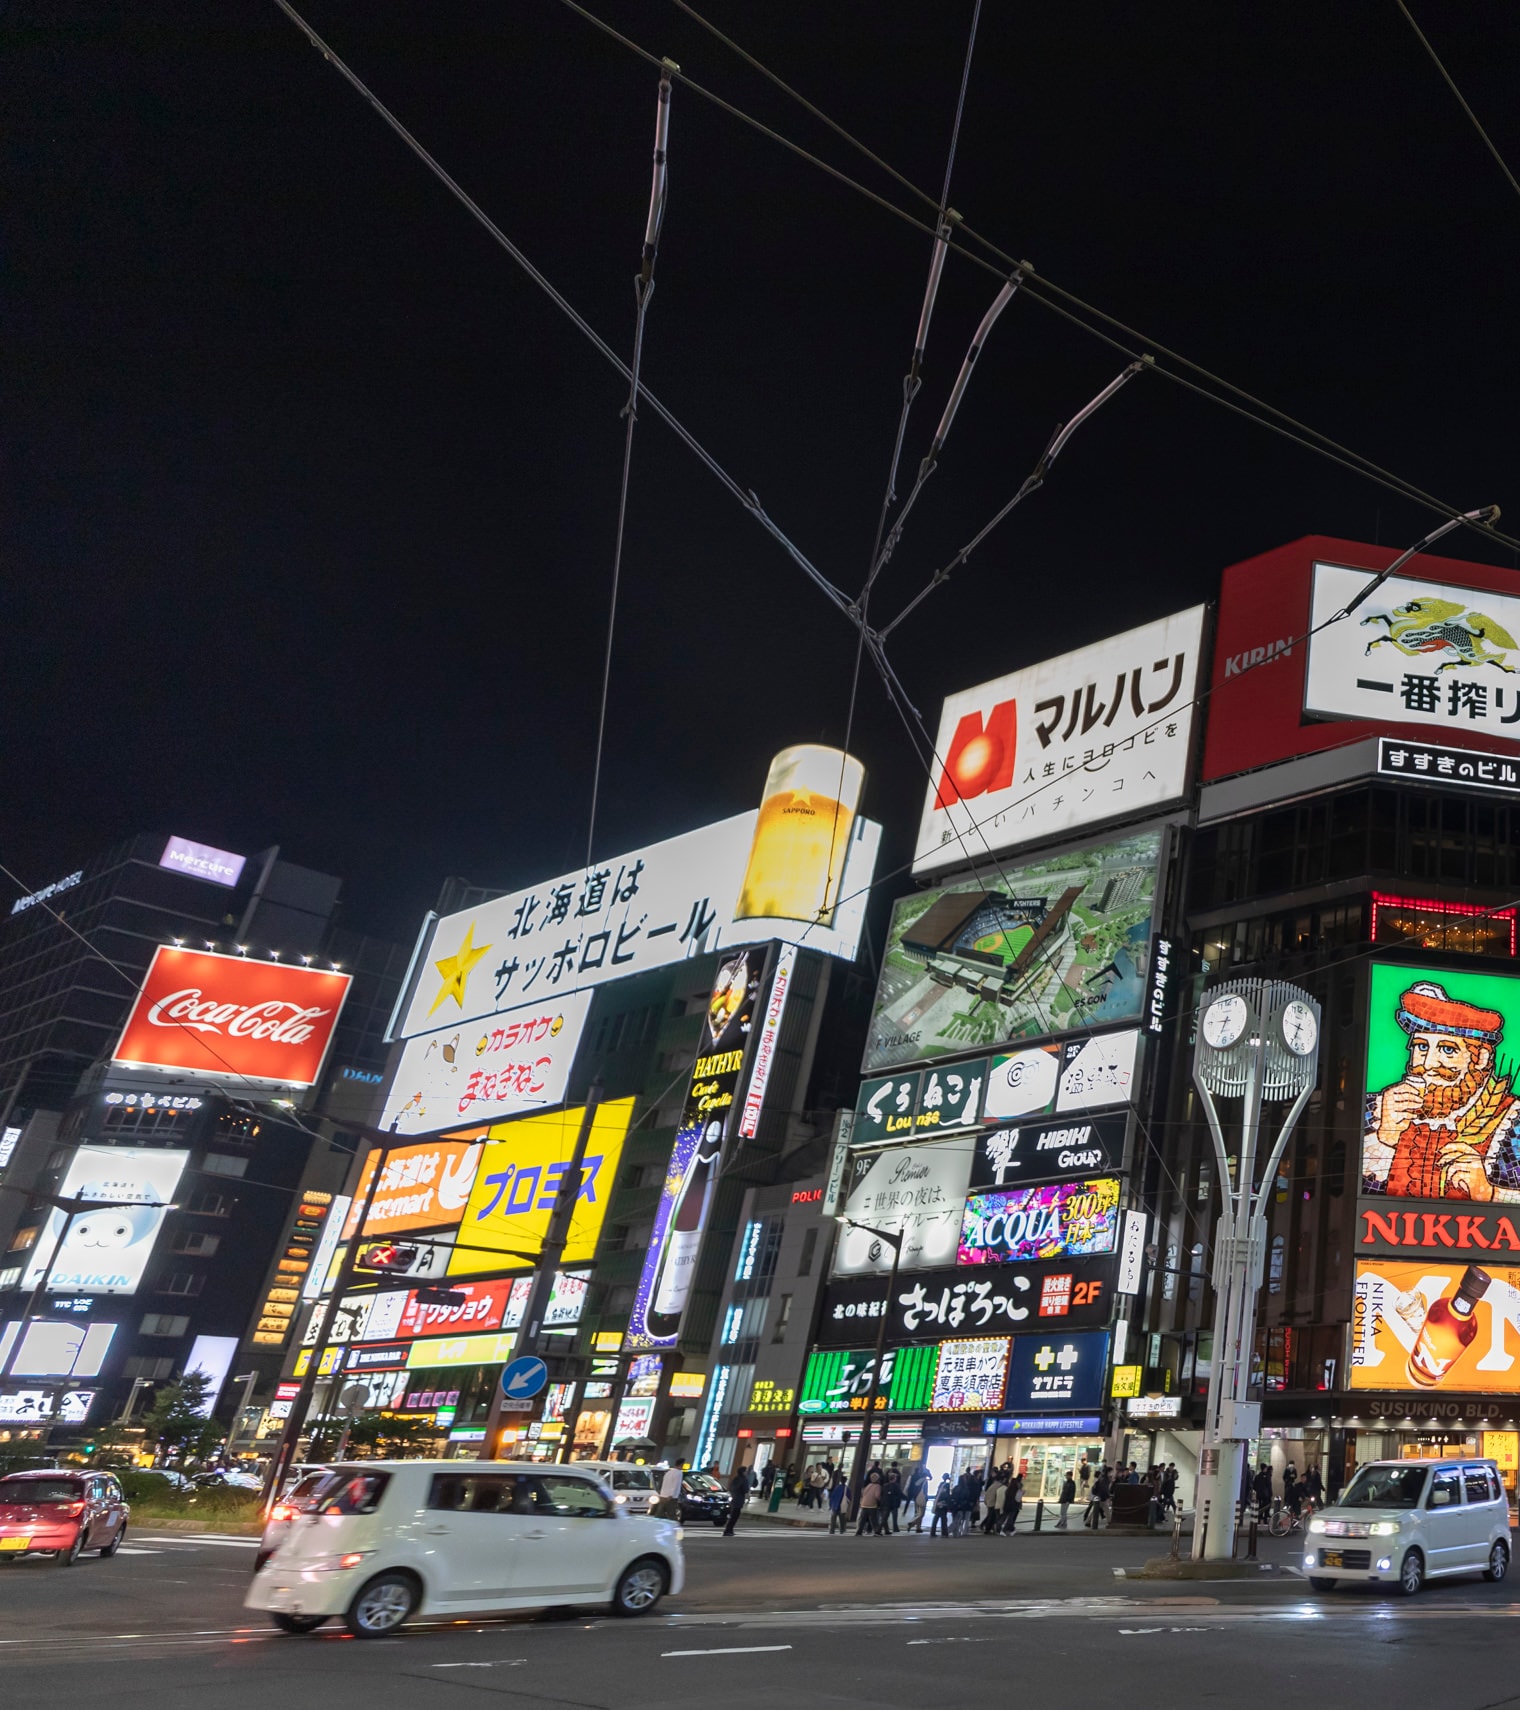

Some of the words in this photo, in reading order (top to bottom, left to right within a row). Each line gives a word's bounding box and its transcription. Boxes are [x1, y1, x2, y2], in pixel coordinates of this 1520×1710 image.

[1224, 636, 1293, 678] KIRIN
[1034, 652, 1185, 750] マルハン
[1388, 749, 1516, 783] すすきのビル
[782, 806, 817, 817] SAPPORO
[169, 850, 234, 876] Mercure
[507, 860, 644, 941] 北海道は
[494, 897, 717, 1003] サッポロビール
[147, 988, 331, 1046] Coca-Cola
[769, 976, 787, 1018] カラオケ
[487, 1015, 554, 1053] カラオケ
[458, 1056, 552, 1113] まねきねこ
[693, 1049, 744, 1079] HATHYR
[1036, 1126, 1092, 1151] HIBIKI
[477, 1155, 603, 1222] プロミス
[966, 1206, 1062, 1249] ACQUA
[1065, 1223, 1110, 1246] 日本一
[52, 1273, 129, 1286] DAIKIN
[1072, 1281, 1103, 1306] 2F
[1352, 1281, 1369, 1366] FRONTIER
[1370, 1282, 1384, 1337] NIKKA
[1369, 1401, 1459, 1418] SUSUKINO
[1465, 1403, 1504, 1418] BLD.
